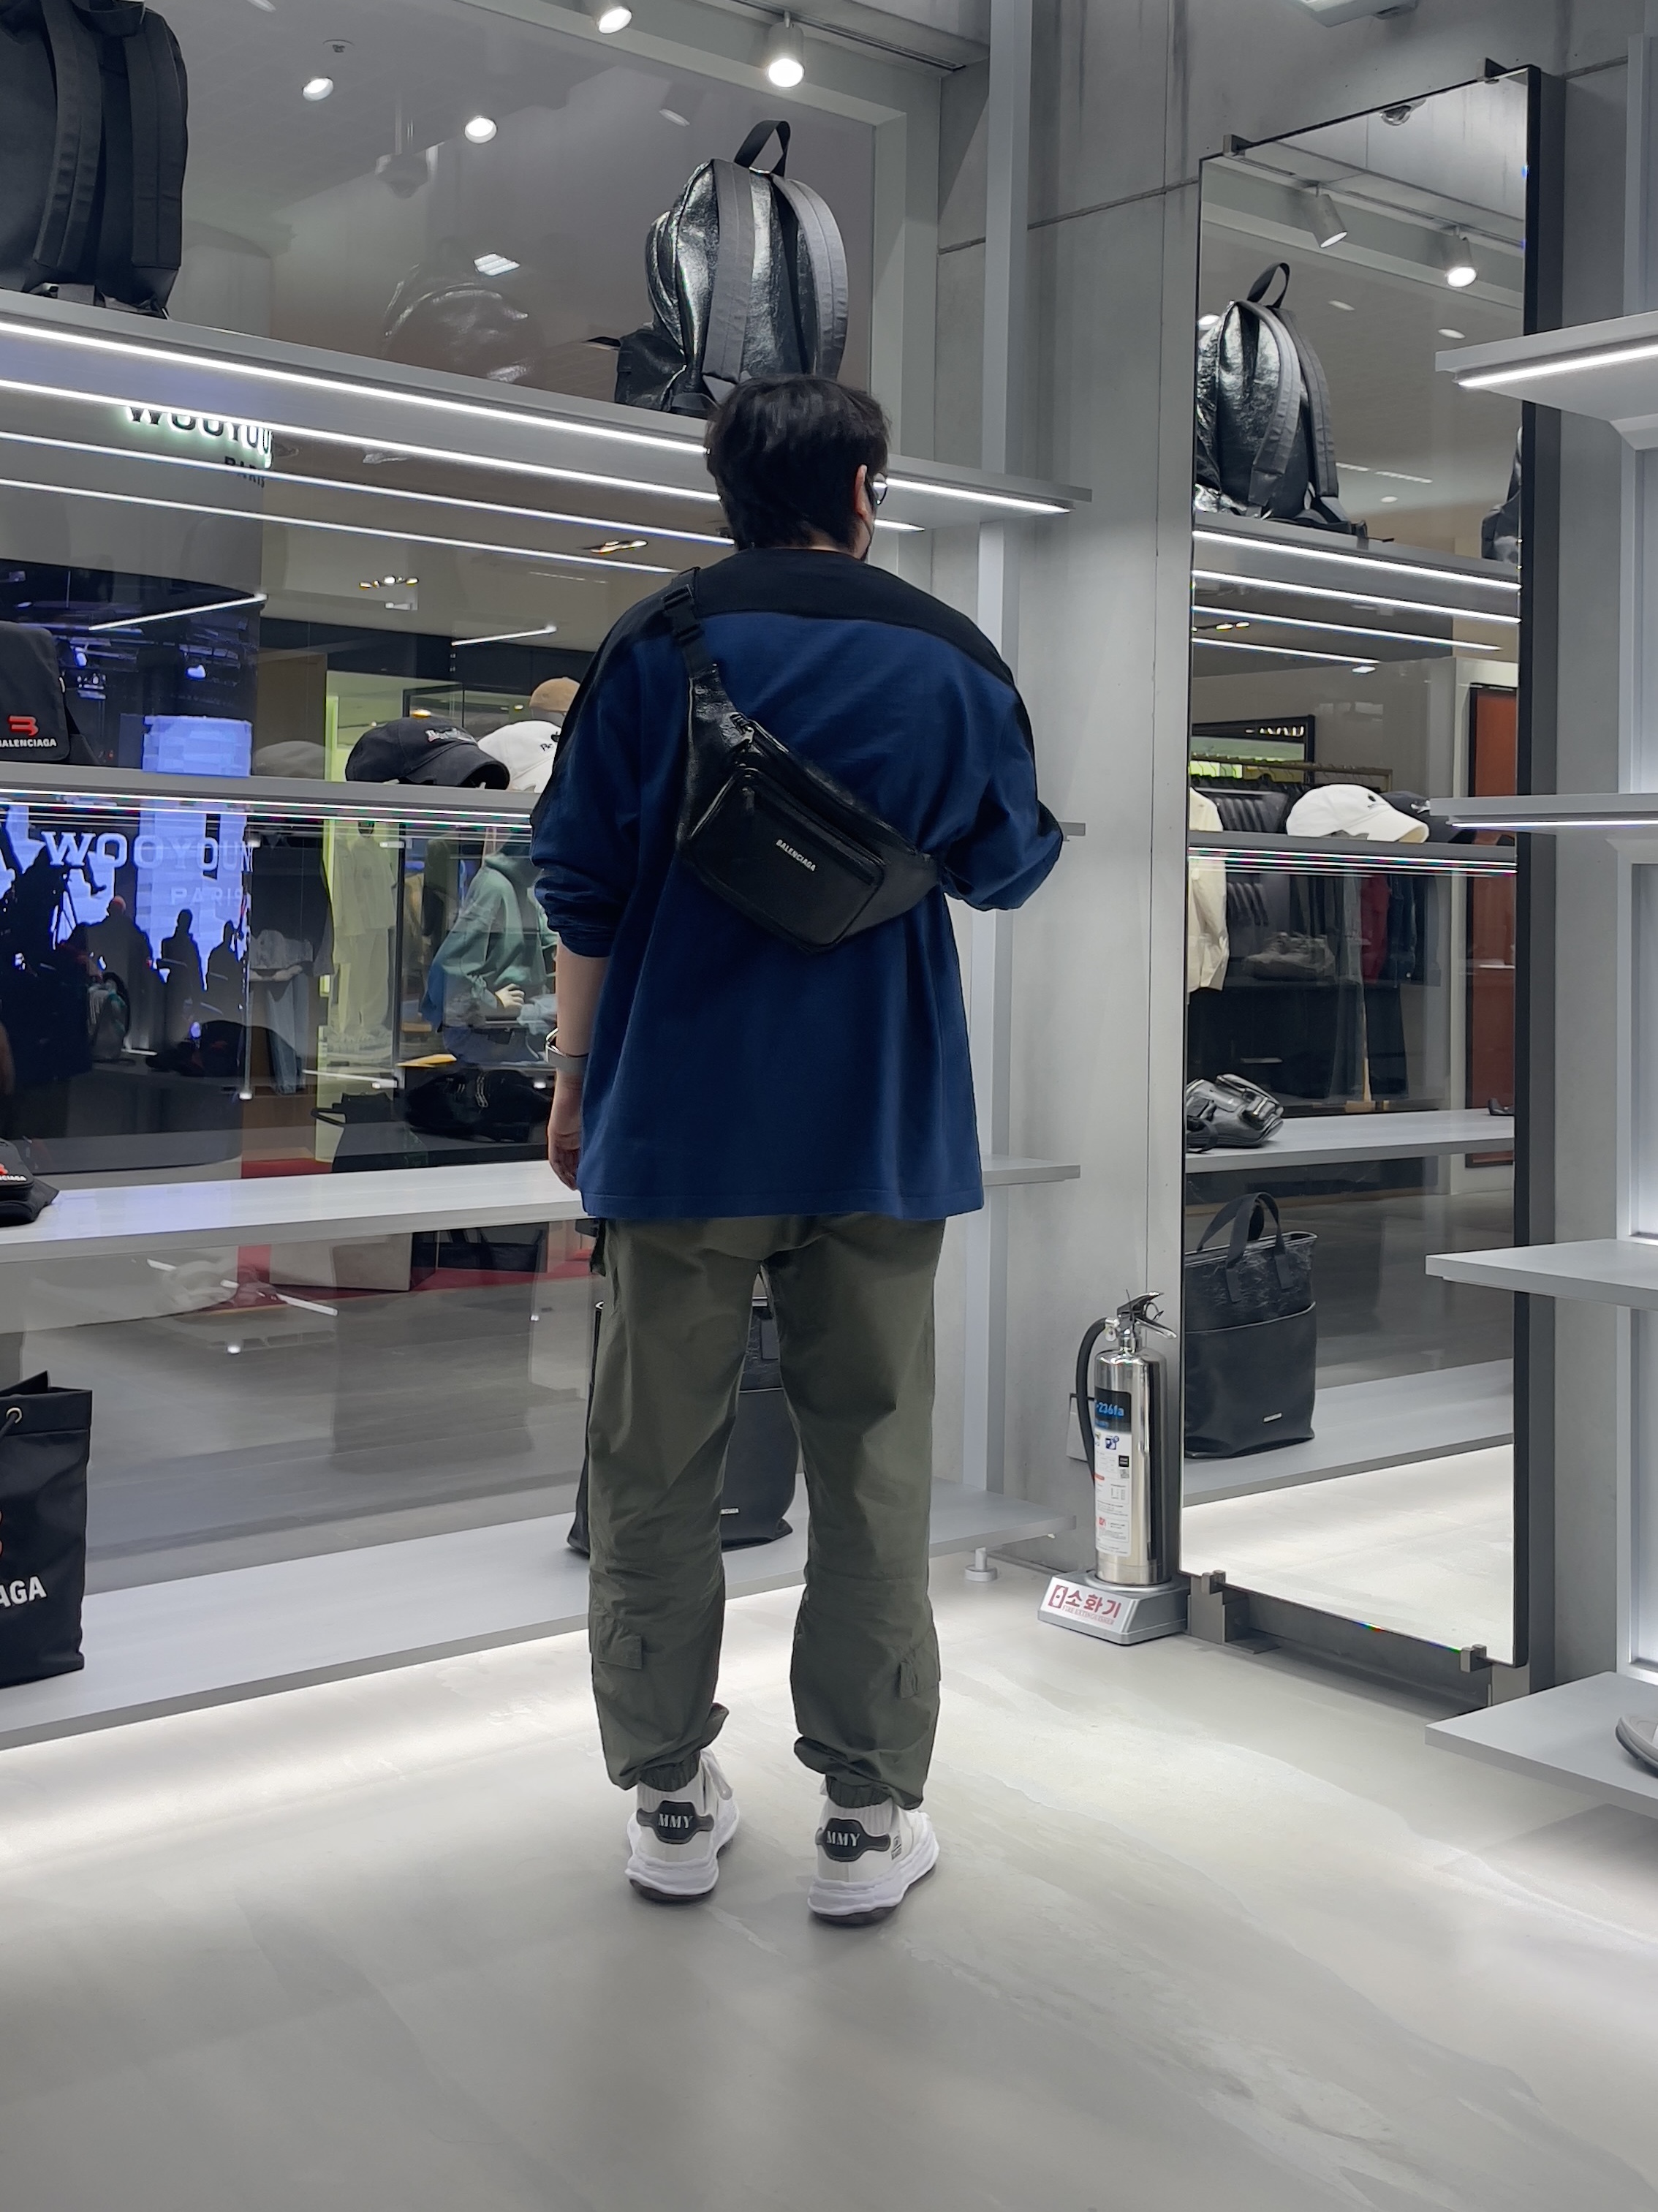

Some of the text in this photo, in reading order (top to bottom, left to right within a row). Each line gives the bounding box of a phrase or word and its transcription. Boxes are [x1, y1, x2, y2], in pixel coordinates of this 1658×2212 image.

[0, 739, 56, 747] ALENCIAGA
[776, 839, 816, 872] BALENCIAGA
[1065, 1590, 1121, 1618] 소화기
[659, 1813, 693, 1829] MMY
[827, 1830, 860, 1846] MMY
